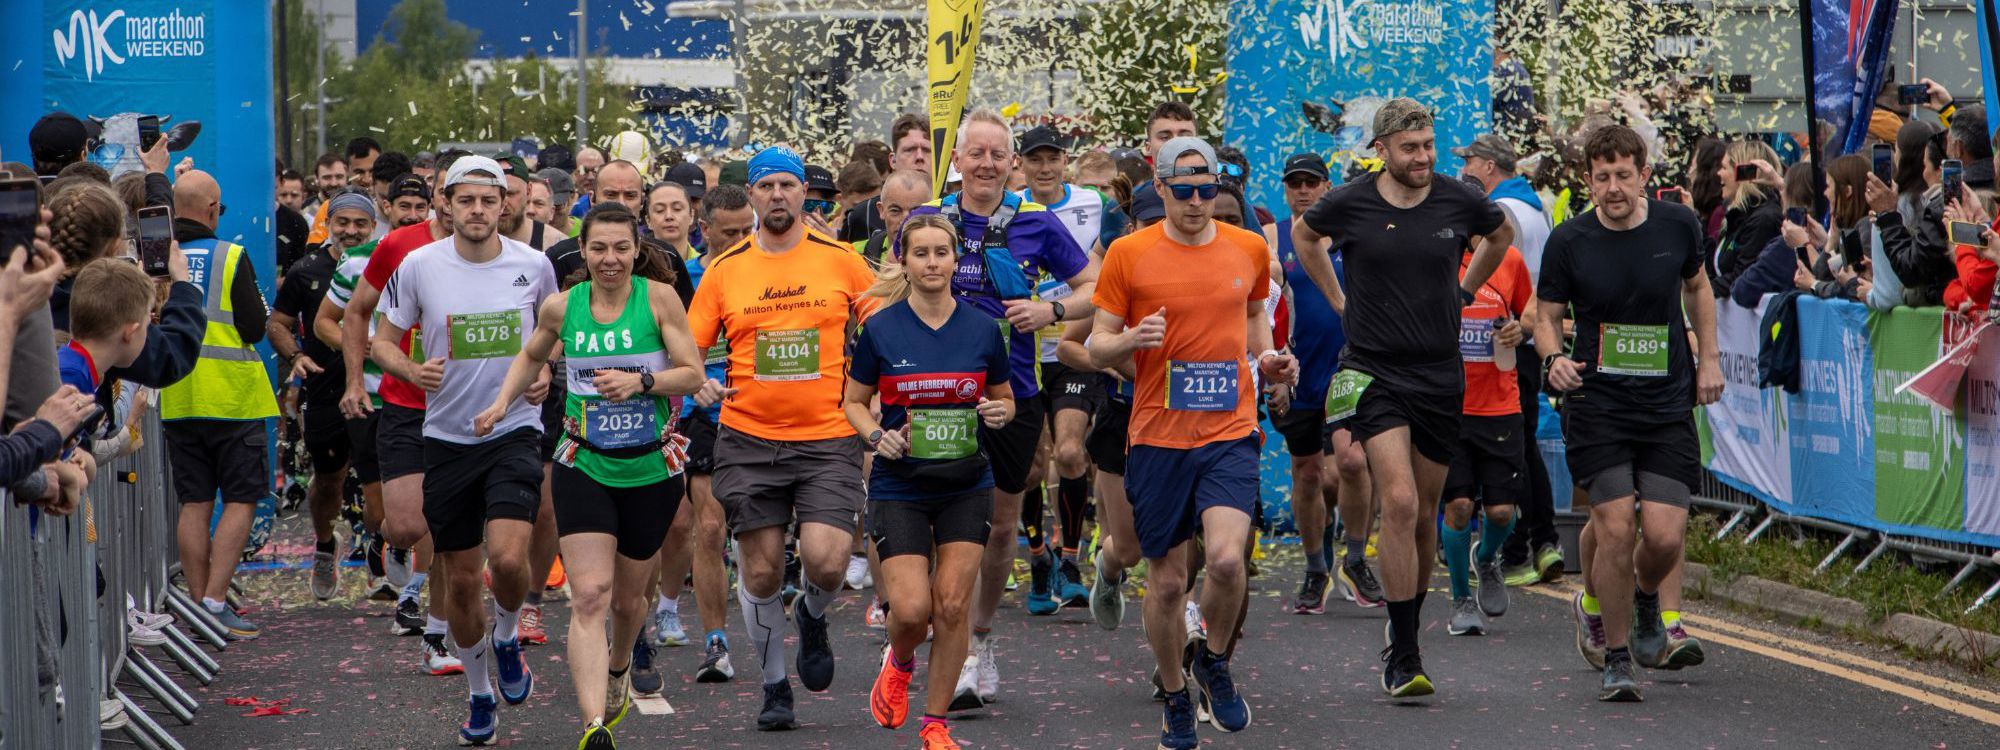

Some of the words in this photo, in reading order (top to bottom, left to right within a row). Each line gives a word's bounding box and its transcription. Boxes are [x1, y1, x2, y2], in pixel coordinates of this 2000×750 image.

[1370, 26, 1443, 43] WEEKEND
[53, 9, 125, 83] MK
[125, 8, 204, 40] marathon
[126, 41, 204, 57] WEEKEND
[758, 285, 806, 301] Marshall
[743, 306, 773, 315] Milton
[776, 301, 811, 311] Keynes
[814, 299, 827, 308] AC
[465, 325, 510, 343] 6178
[575, 329, 632, 353] PAGS
[1459, 330, 1491, 344] 2019
[766, 343, 810, 359] 4104
[1616, 338, 1658, 354] 6189
[896, 381, 918, 392] HOLME
[918, 379, 957, 390] PIERREPONT
[1184, 376, 1228, 393] 2112
[598, 413, 644, 431] 2032
[925, 424, 968, 440] 6071
